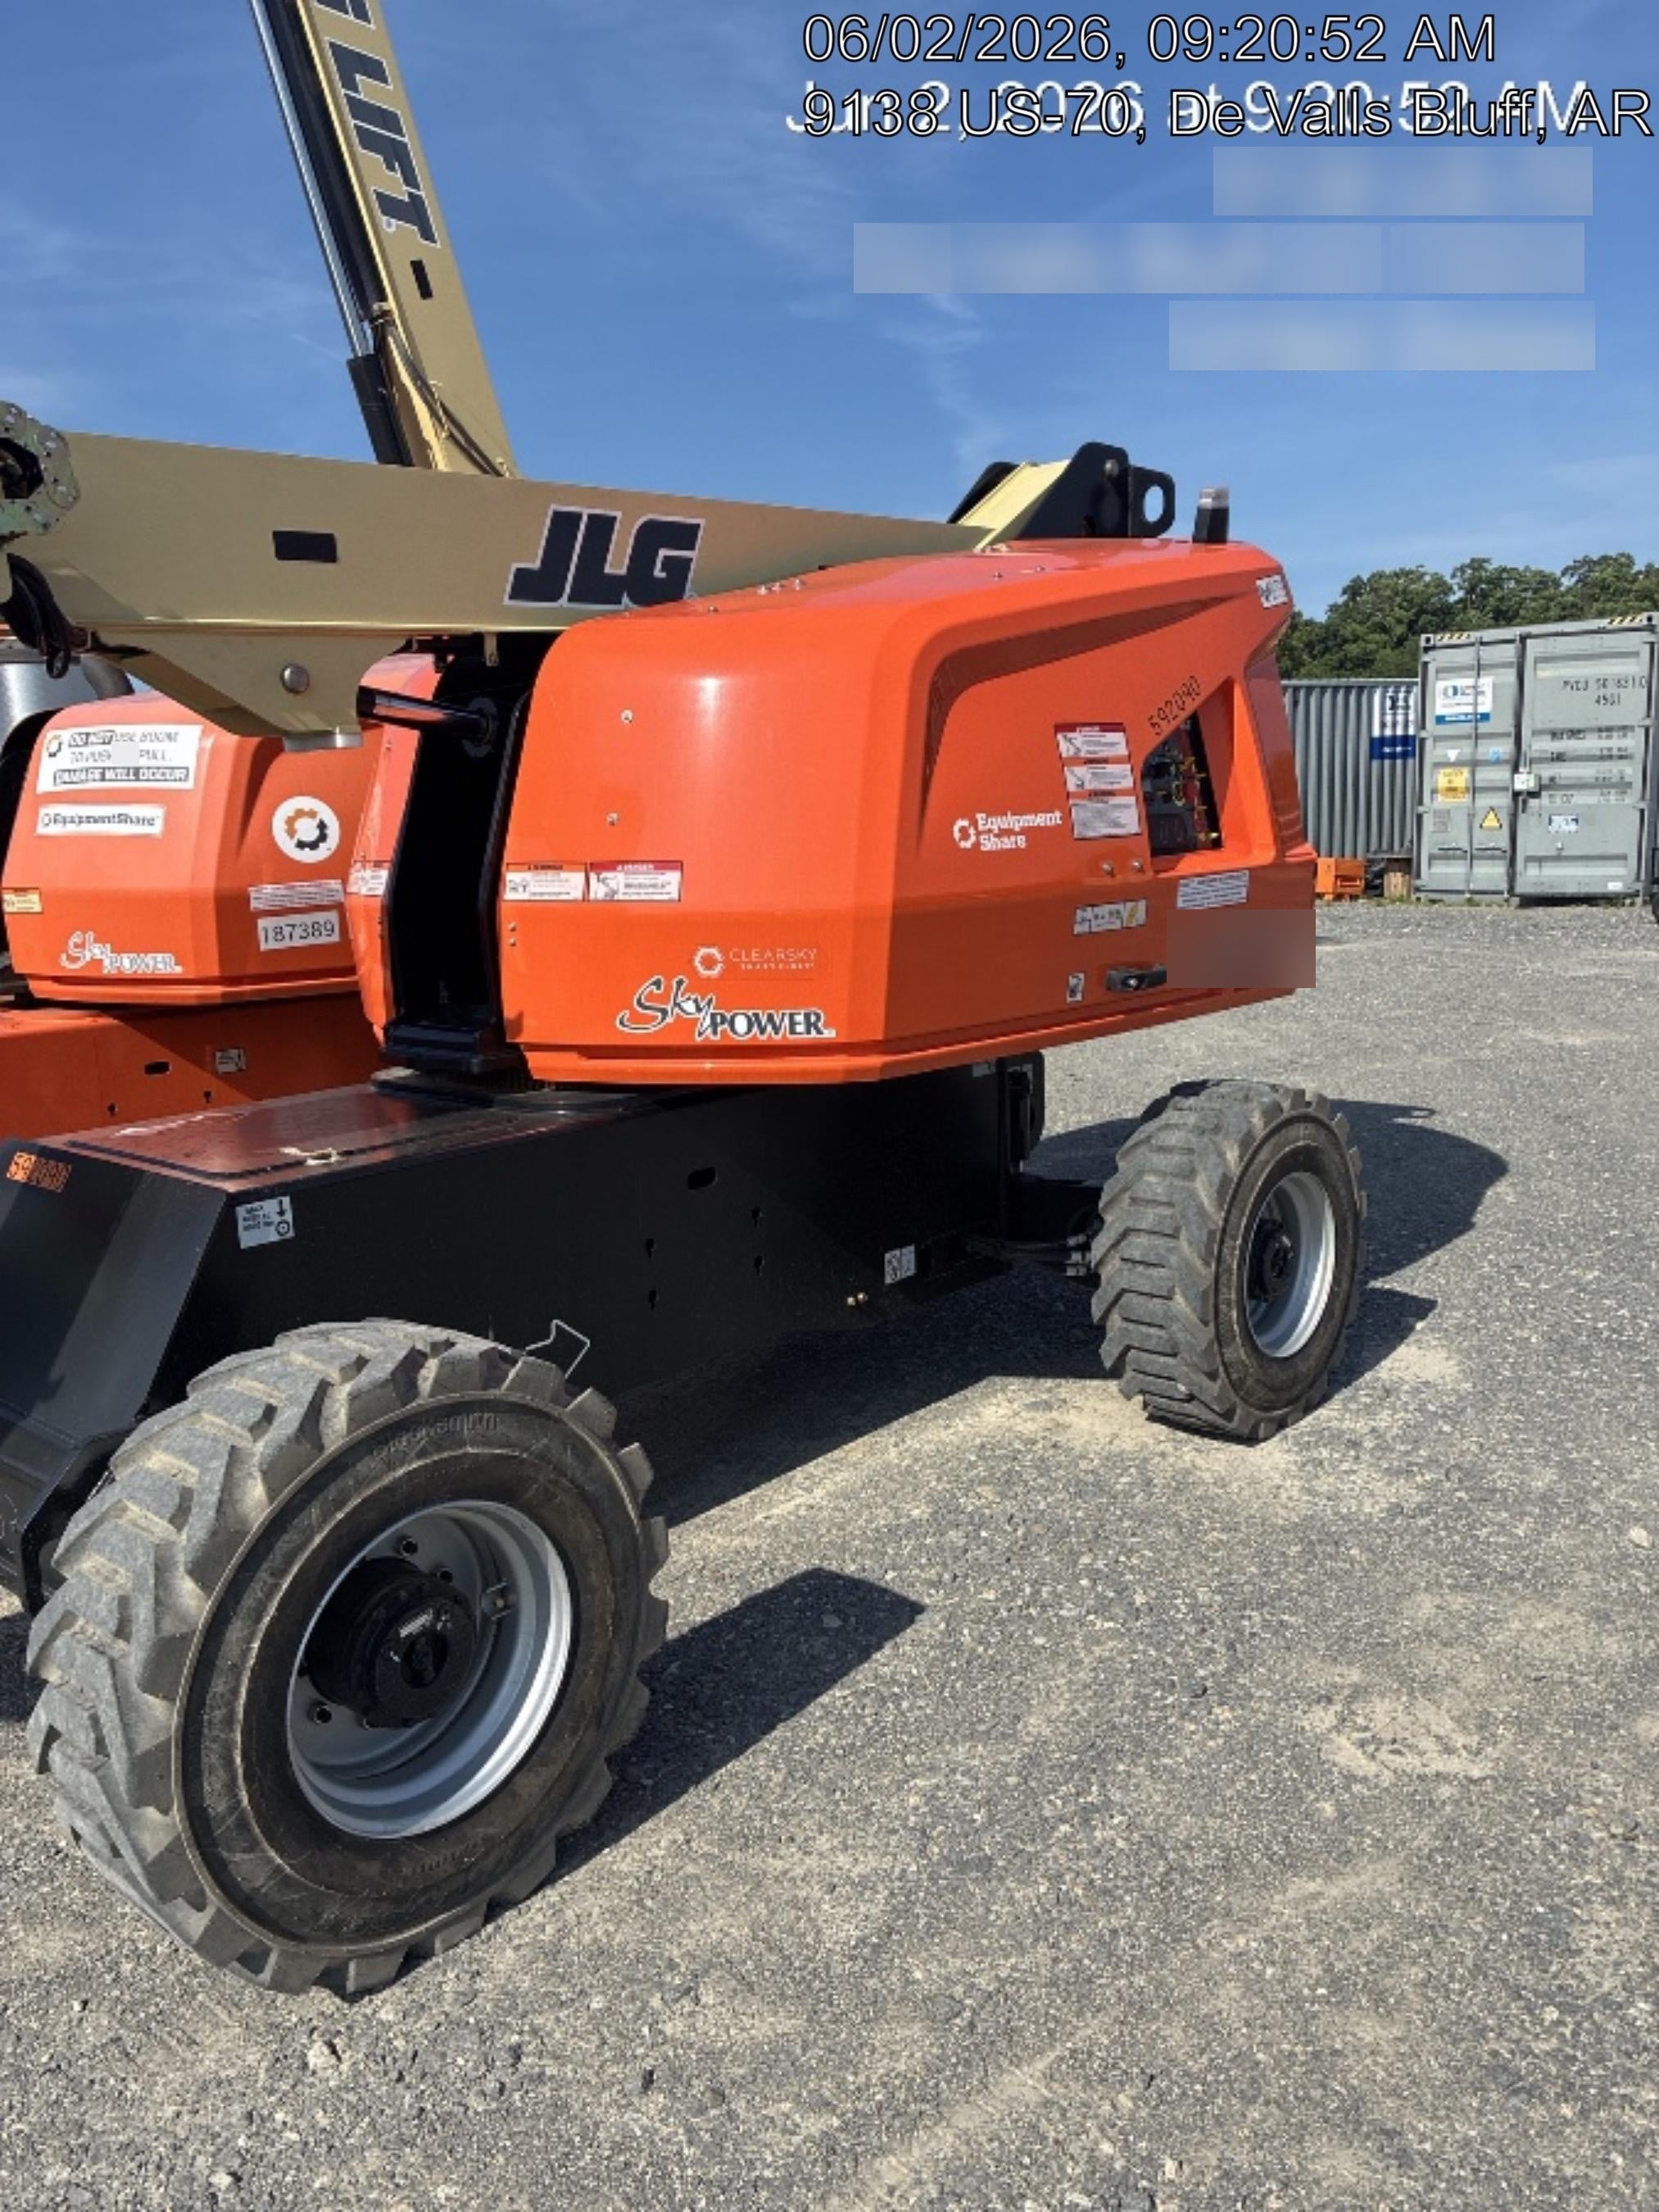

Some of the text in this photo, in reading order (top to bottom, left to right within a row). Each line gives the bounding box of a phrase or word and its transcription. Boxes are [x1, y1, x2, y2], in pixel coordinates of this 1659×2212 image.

[324, 37, 441, 249] LIFT
[503, 504, 705, 610] JLG
[975, 810, 1063, 834] Equipment
[980, 833, 1027, 851] Share
[261, 919, 335, 945] 187389
[728, 948, 818, 962] CLEARSKY
